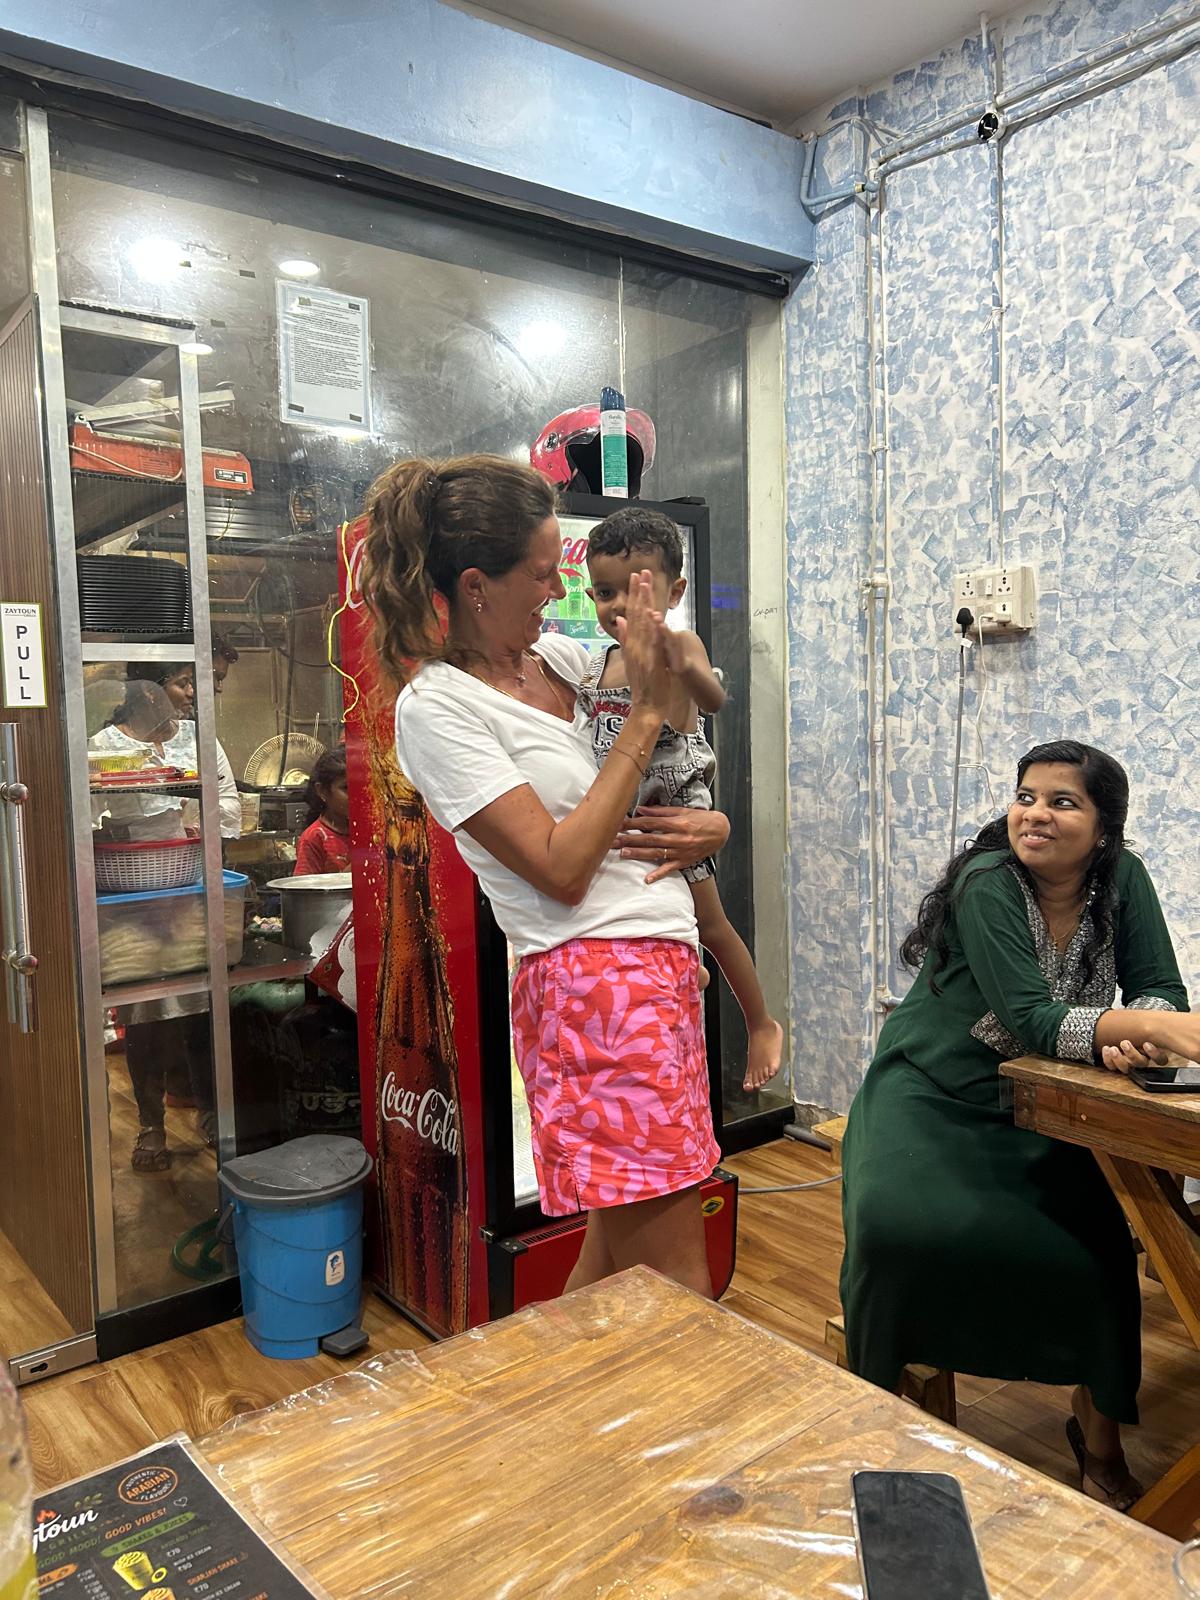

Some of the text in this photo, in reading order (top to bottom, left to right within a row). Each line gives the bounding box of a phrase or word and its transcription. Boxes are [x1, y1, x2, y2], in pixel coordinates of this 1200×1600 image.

[16, 625, 32, 700] PULL
[381, 1071, 459, 1156] Coca-Cola
[126, 1472, 171, 1499] ARABIAN
[105, 1507, 167, 1540] GOOD VIBES!
